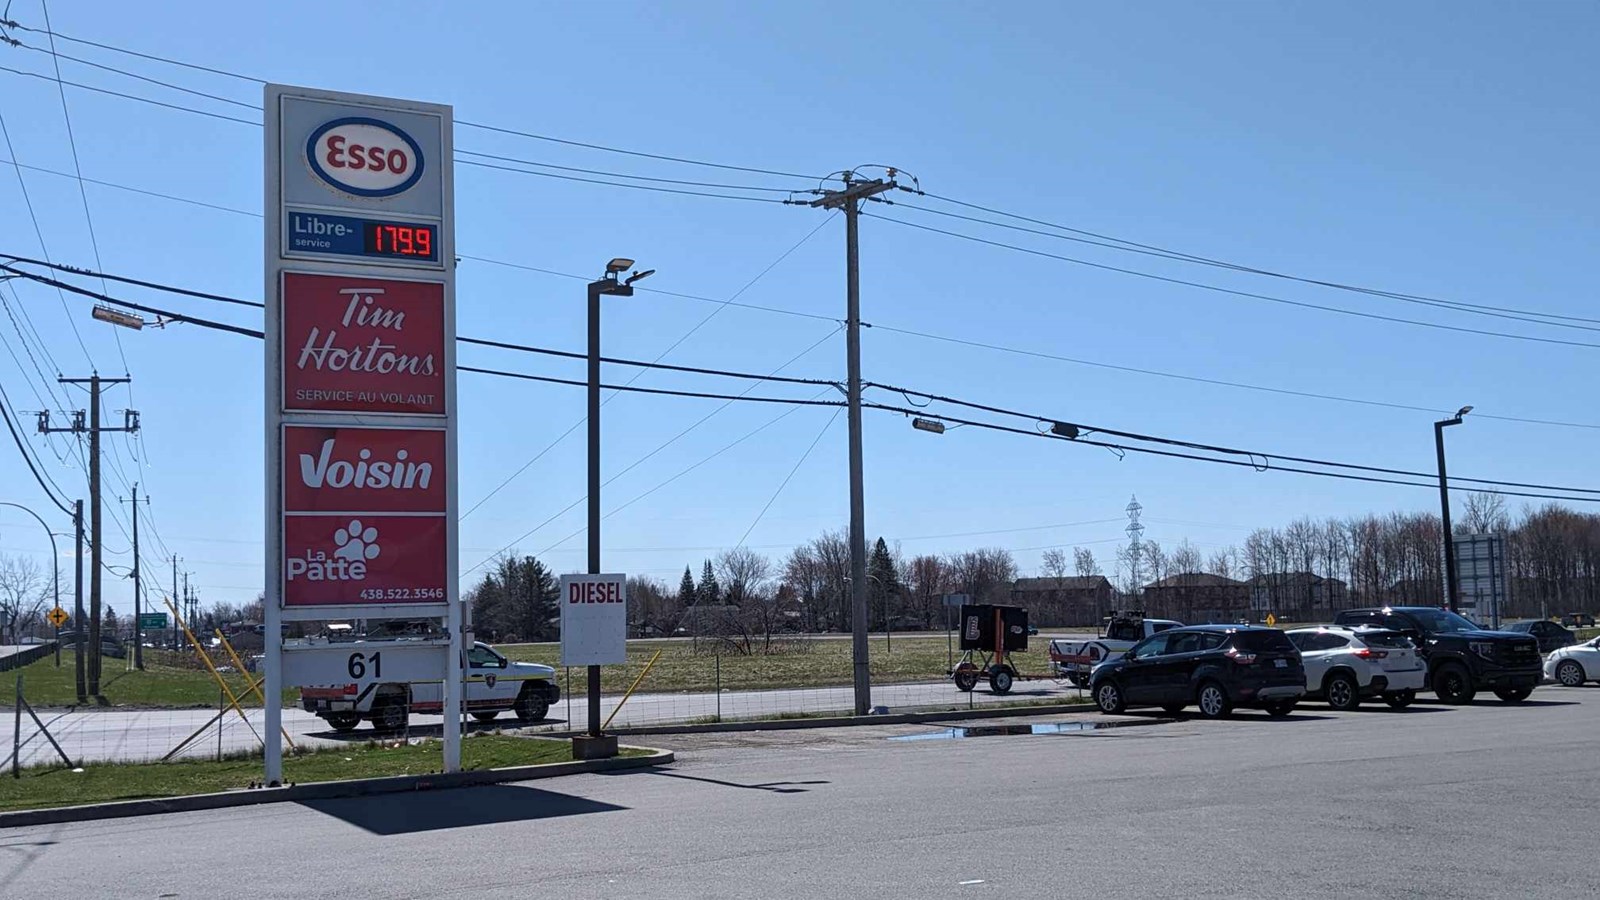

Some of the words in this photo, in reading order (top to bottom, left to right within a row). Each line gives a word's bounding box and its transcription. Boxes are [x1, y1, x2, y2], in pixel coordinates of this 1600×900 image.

[294, 215, 353, 236] Libre-
[295, 238, 331, 248] service
[376, 225, 431, 255] 179.9
[339, 288, 406, 331] Tim
[297, 326, 436, 376] Hortons
[296, 389, 354, 402] SERVICE
[358, 391, 376, 403] AU
[380, 393, 435, 405] VOLANT
[299, 438, 432, 489] Voisin
[306, 548, 326, 561] La
[287, 557, 367, 581] Patte
[360, 588, 444, 600] 438.522.3546
[569, 582, 623, 604] DIESEL
[348, 651, 382, 679] 61
